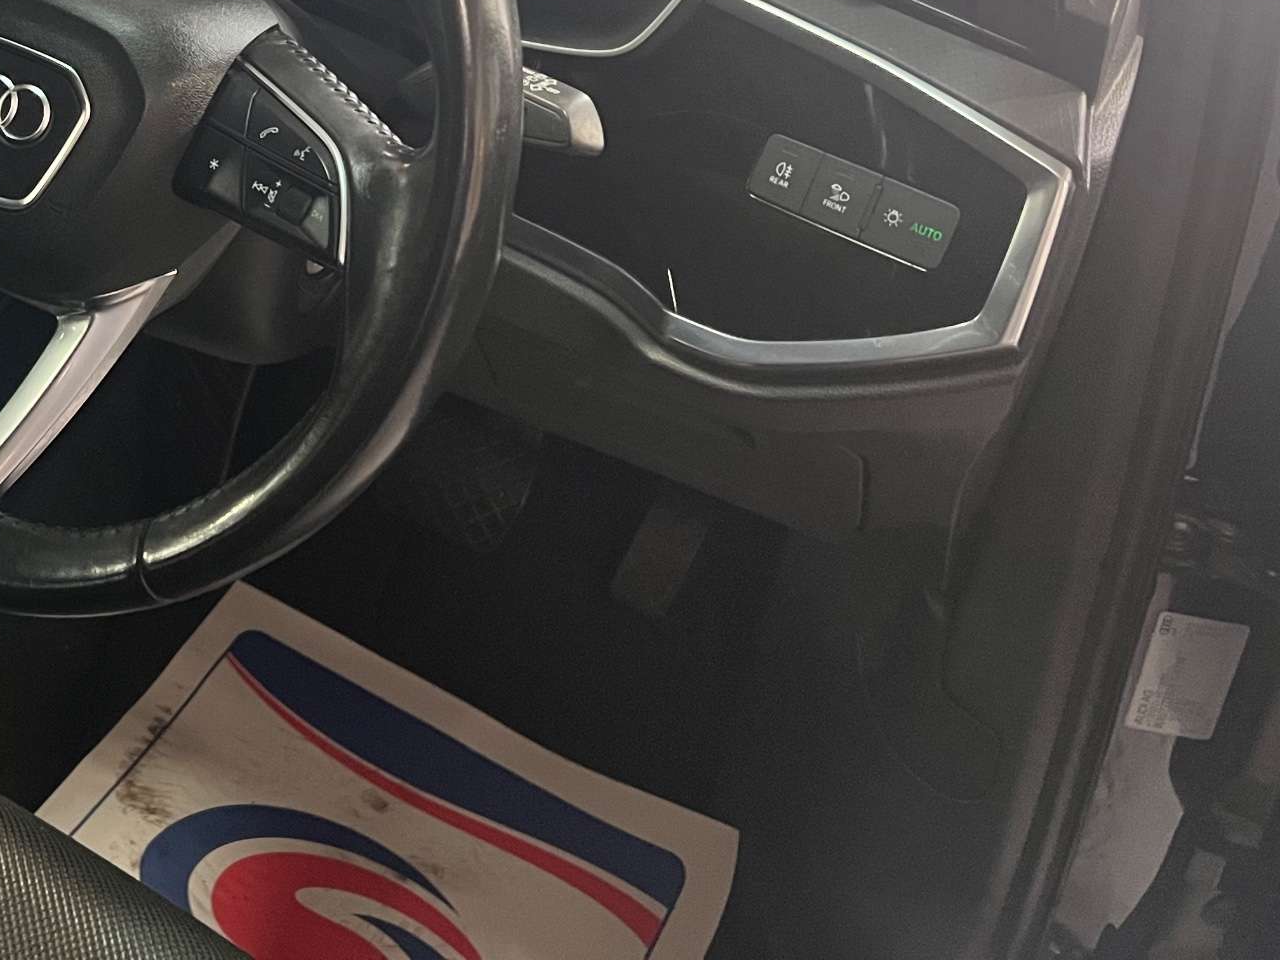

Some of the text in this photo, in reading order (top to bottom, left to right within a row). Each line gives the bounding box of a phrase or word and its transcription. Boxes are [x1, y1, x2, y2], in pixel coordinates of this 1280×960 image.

[769, 176, 789, 188] REAR
[822, 199, 846, 213] FRONT
[911, 223, 942, 240] AUTO
